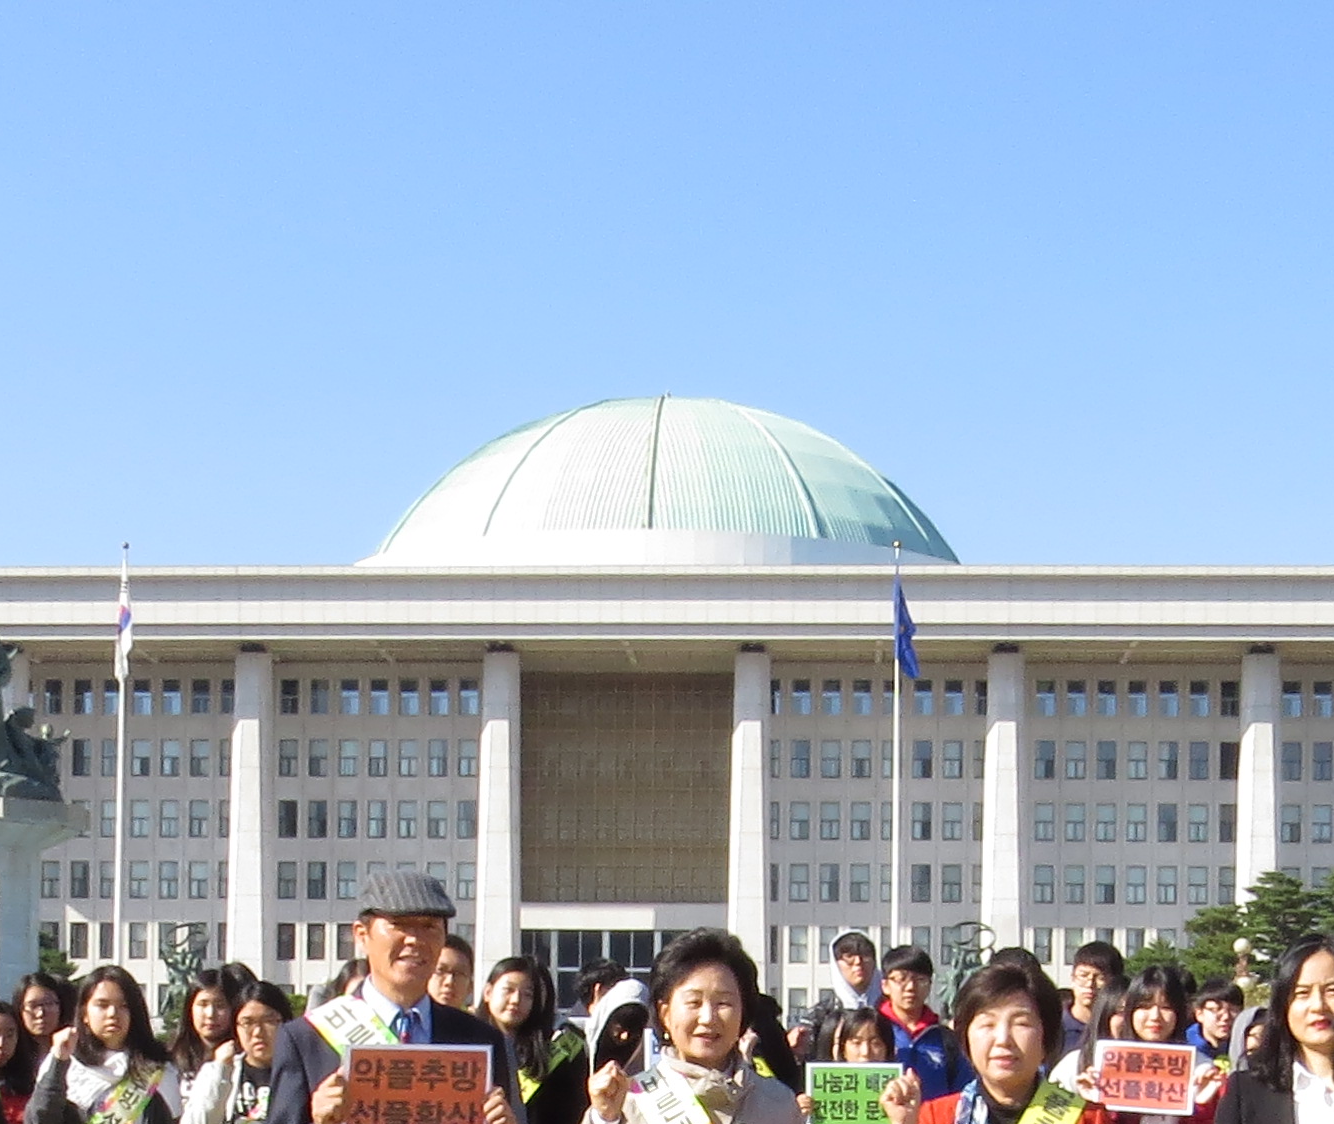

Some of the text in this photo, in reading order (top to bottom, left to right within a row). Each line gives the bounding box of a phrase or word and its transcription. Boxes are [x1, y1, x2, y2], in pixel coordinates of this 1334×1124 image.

[354, 1057, 481, 1092] 악플추방
[1103, 1050, 1188, 1077] 악플추방
[813, 1072, 859, 1094] 나눔과
[1100, 1078, 1186, 1103] 선플확산
[814, 1099, 859, 1121] 건전한
